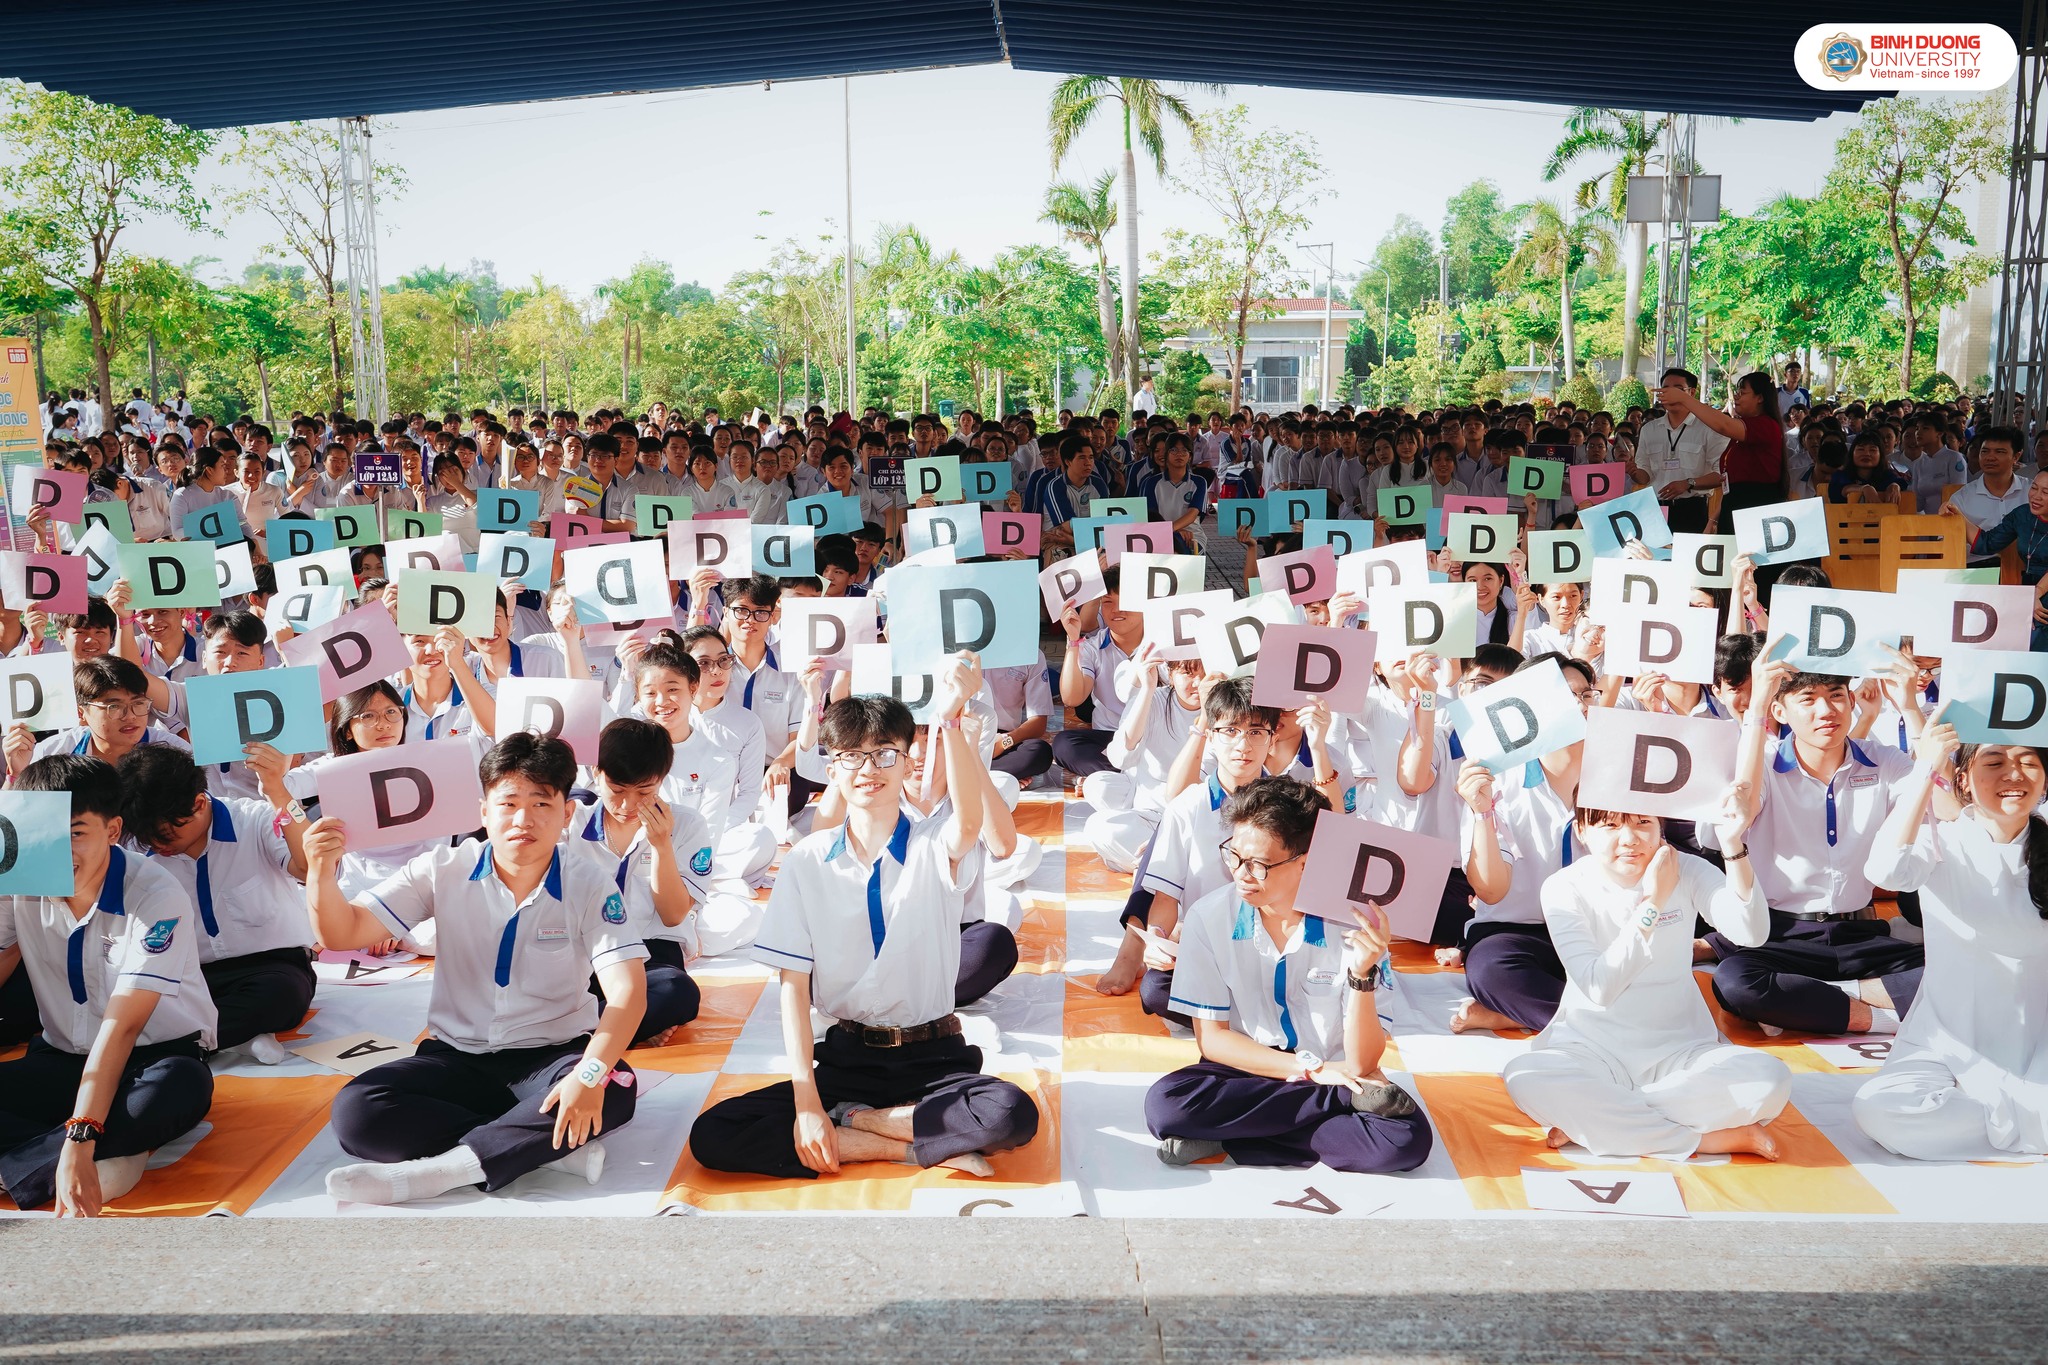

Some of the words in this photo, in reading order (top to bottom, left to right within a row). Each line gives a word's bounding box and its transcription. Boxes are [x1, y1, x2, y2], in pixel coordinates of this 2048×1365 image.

[32, 478, 62, 507] D
[359, 471, 375, 482] LỚP
[377, 472, 398, 482] 12A3
[873, 475, 889, 485] LỚP
[891, 475, 906, 485] 12A
[919, 466, 942, 494] D
[976, 471, 996, 494] D
[1523, 466, 1545, 491] D
[1586, 473, 1610, 497] D
[498, 498, 521, 524] D
[652, 504, 674, 530] D
[805, 503, 828, 530] D
[1235, 507, 1255, 530] D
[1288, 499, 1310, 525] D
[1394, 495, 1416, 519] D
[200, 512, 224, 538] D
[334, 515, 358, 541] D
[405, 518, 425, 538] D
[929, 517, 957, 548] D
[1001, 521, 1025, 546] D
[1469, 524, 1496, 554] D
[1608, 510, 1643, 549] D
[1761, 515, 1797, 554] D
[289, 529, 314, 556] D
[695, 532, 728, 567] D
[763, 535, 791, 568] D
[1327, 530, 1352, 560] D
[1552, 541, 1581, 574] D
[148, 556, 187, 596] D
[501, 546, 529, 578] D
[1695, 544, 1725, 577] D
[25, 565, 60, 600] D
[596, 558, 638, 606] D
[1055, 568, 1082, 602] D
[1147, 566, 1178, 600] D
[1284, 562, 1316, 596] D
[1622, 574, 1658, 605] D
[282, 593, 313, 622] D
[429, 584, 466, 625] D
[808, 613, 846, 656] D
[939, 587, 997, 655] D
[1405, 600, 1444, 646] D
[1807, 604, 1857, 658] D
[1952, 601, 1998, 644] D
[321, 631, 373, 679] D
[1224, 615, 1266, 667] D
[1639, 620, 1683, 664] D
[1293, 642, 1342, 692] D
[9, 673, 44, 720] D
[1421, 693, 1432, 708] 23
[1987, 672, 2047, 730] D
[233, 689, 285, 745] D
[523, 695, 565, 739] D
[1485, 696, 1540, 754] D
[1629, 733, 1692, 794] D
[369, 766, 434, 829] D
[1346, 842, 1406, 907] D
[345, 959, 390, 981] A
[336, 1039, 398, 1060] A
[1847, 1041, 1893, 1060] B
[1273, 1186, 1343, 1215] A
[1568, 1178, 1632, 1205] A
